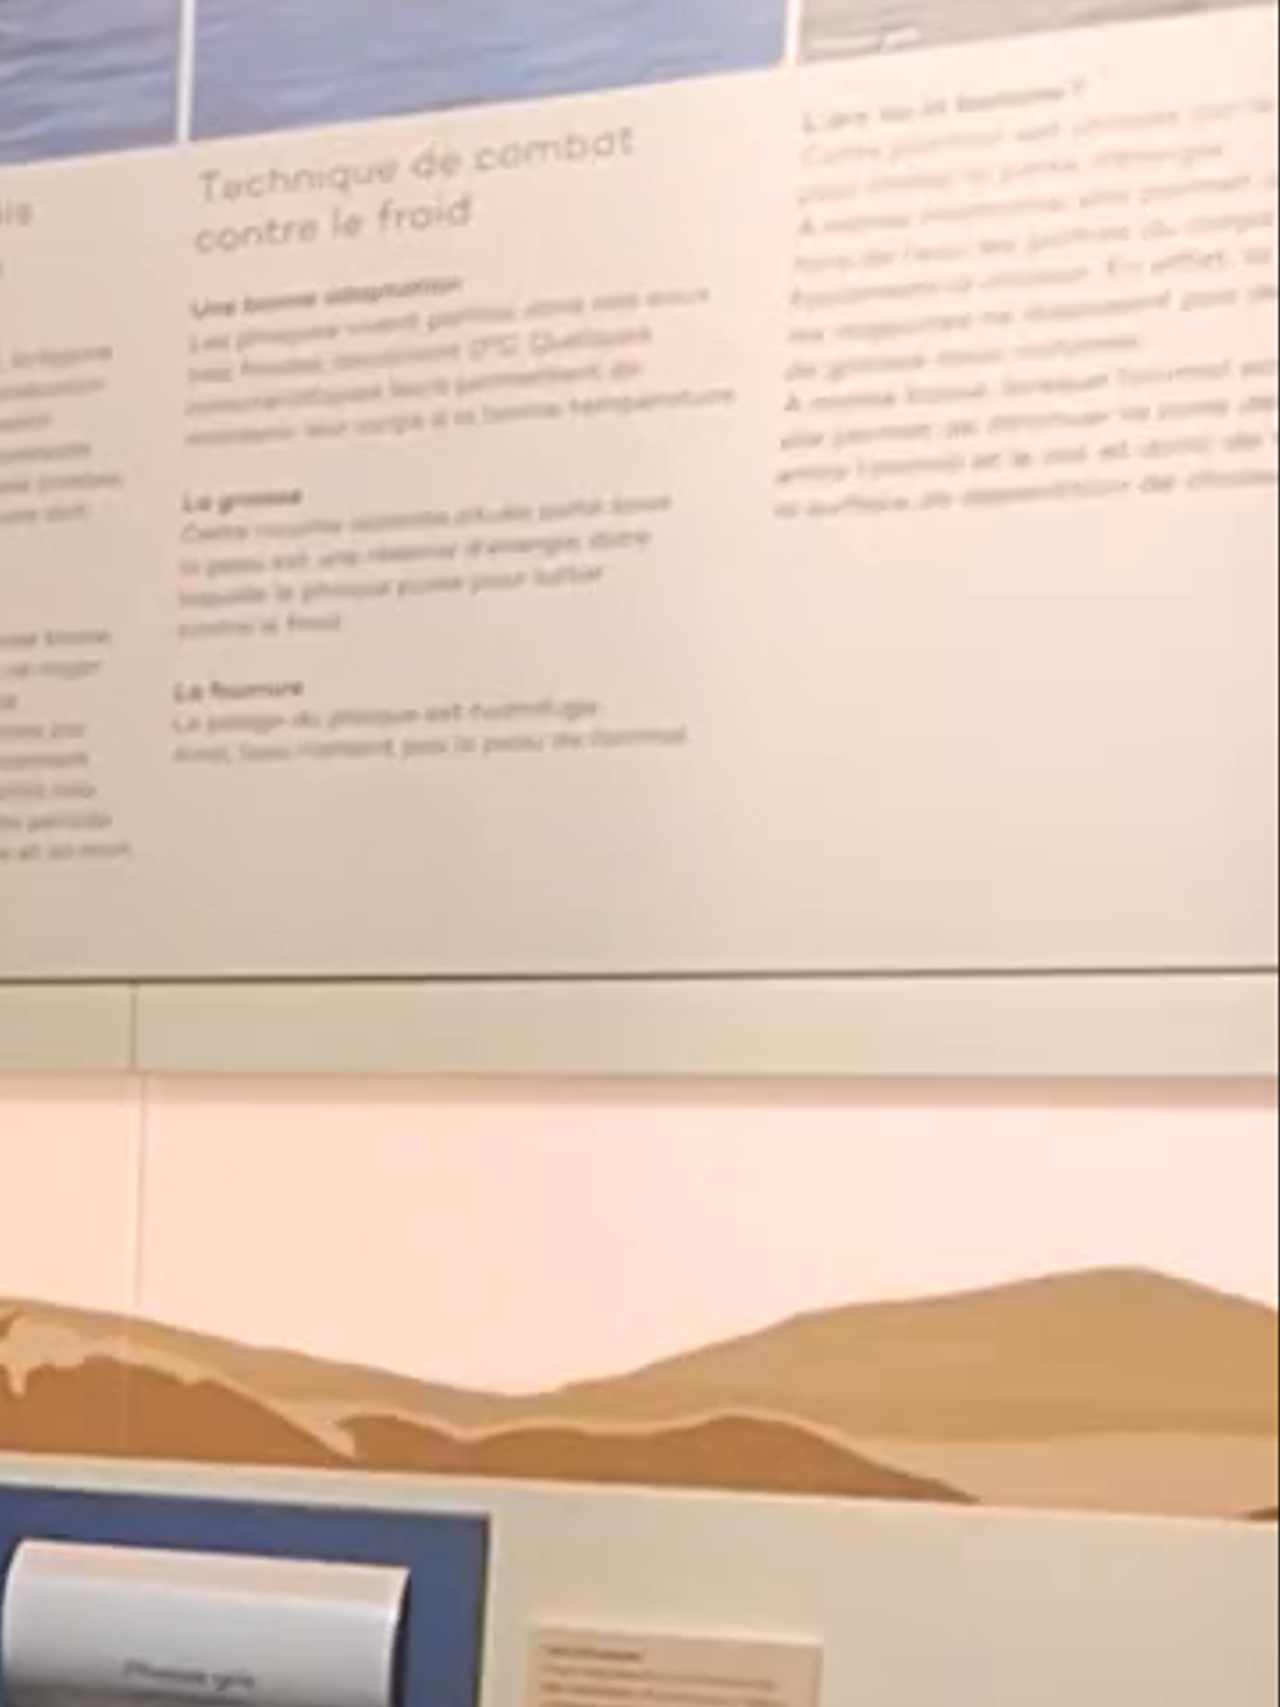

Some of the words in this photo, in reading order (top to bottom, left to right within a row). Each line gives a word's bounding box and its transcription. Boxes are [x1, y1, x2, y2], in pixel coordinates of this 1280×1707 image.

[197, 159, 400, 203] Technique
[409, 142, 462, 180] de
[474, 127, 638, 173] combat
[193, 218, 319, 255] contre
[332, 206, 364, 238] le
[377, 195, 472, 234] froid
